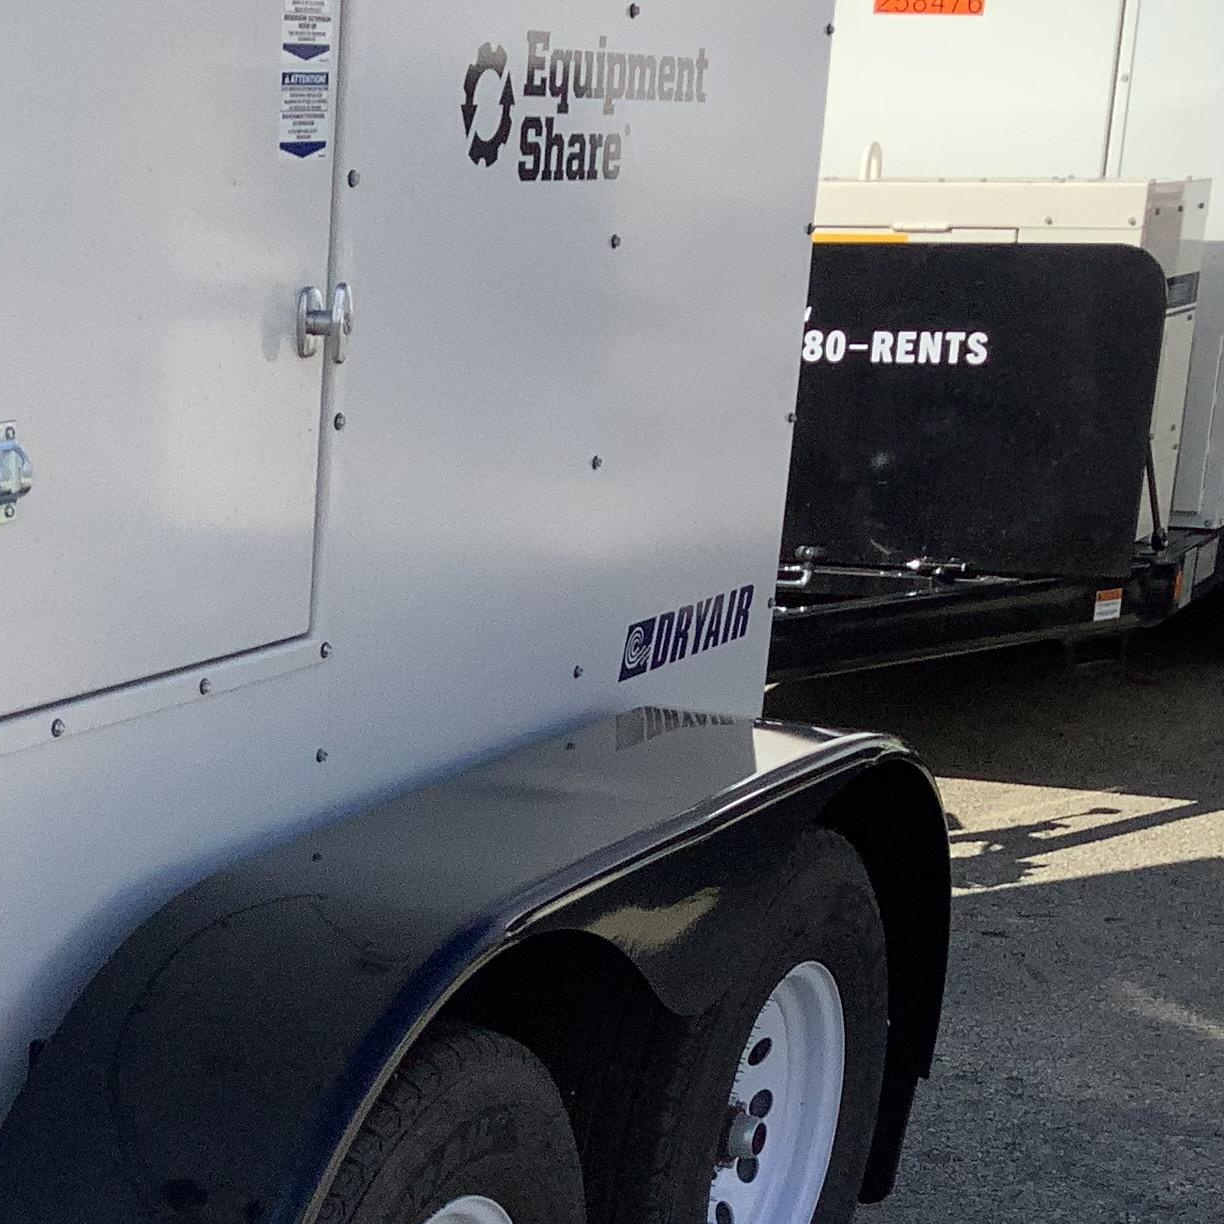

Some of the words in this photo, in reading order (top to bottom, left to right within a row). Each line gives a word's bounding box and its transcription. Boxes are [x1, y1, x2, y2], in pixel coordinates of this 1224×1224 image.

[523, 30, 708, 115] Equipment
[518, 116, 623, 181] Share
[802, 329, 989, 365] 80-RENTS
[650, 584, 754, 671] DRYAIR
